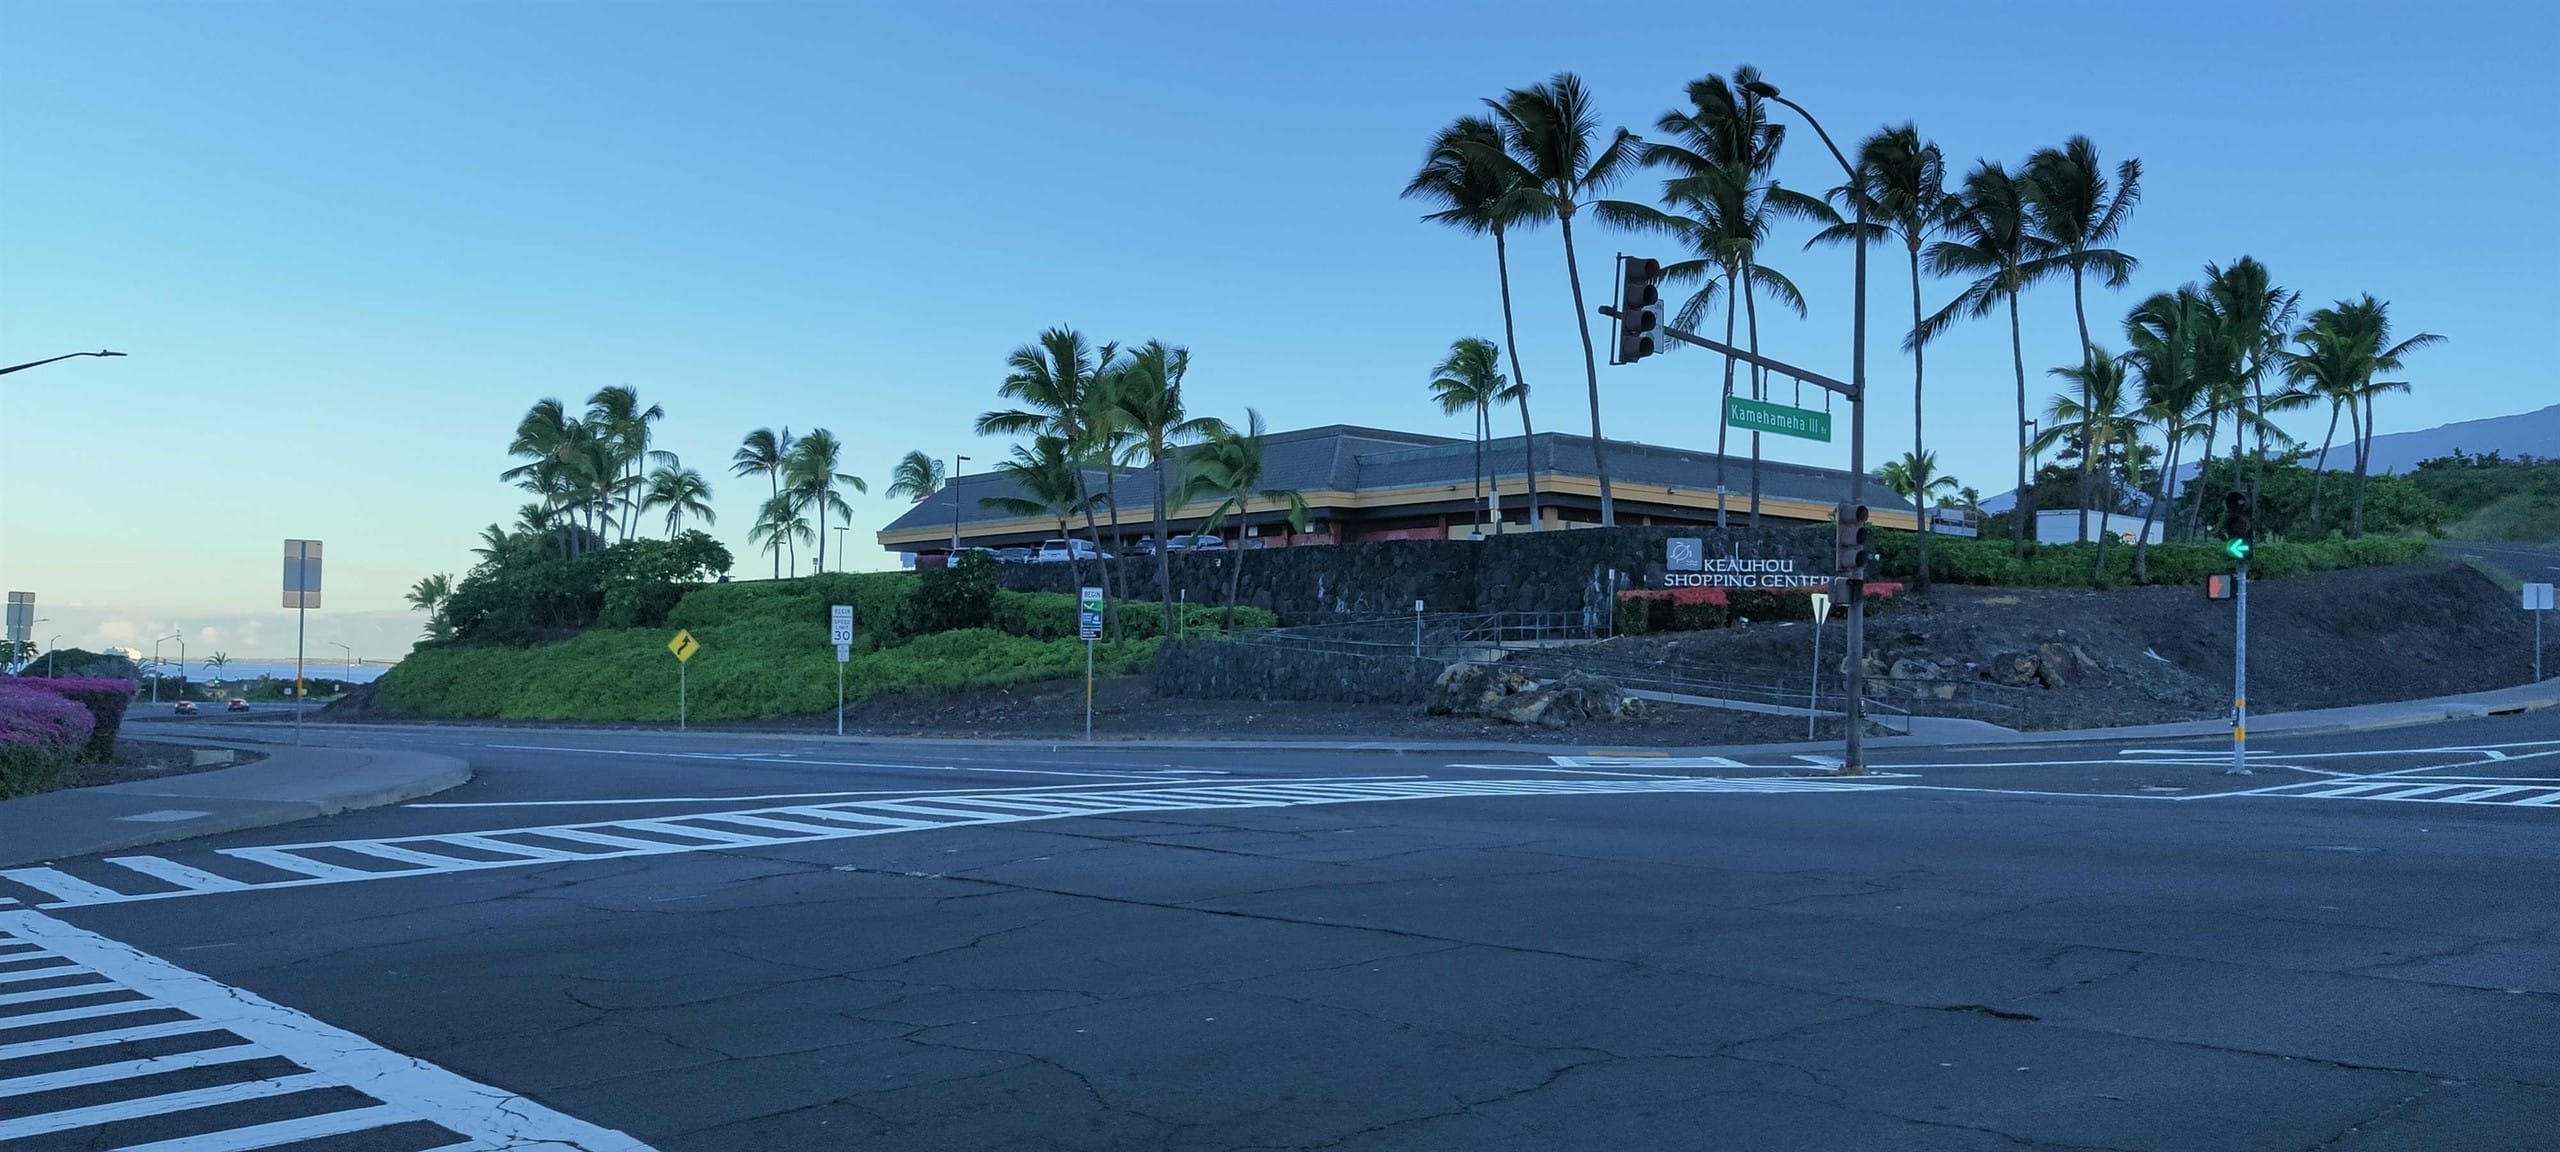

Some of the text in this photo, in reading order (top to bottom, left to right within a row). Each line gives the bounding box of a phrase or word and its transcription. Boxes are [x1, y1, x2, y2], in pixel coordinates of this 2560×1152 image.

[1731, 404, 1805, 431] Kamehameha
[1809, 418, 1818, 433] III
[1704, 559, 1793, 573] KEAUHOU
[1664, 573, 1756, 588] SHOPPING
[834, 631, 850, 640] 30
